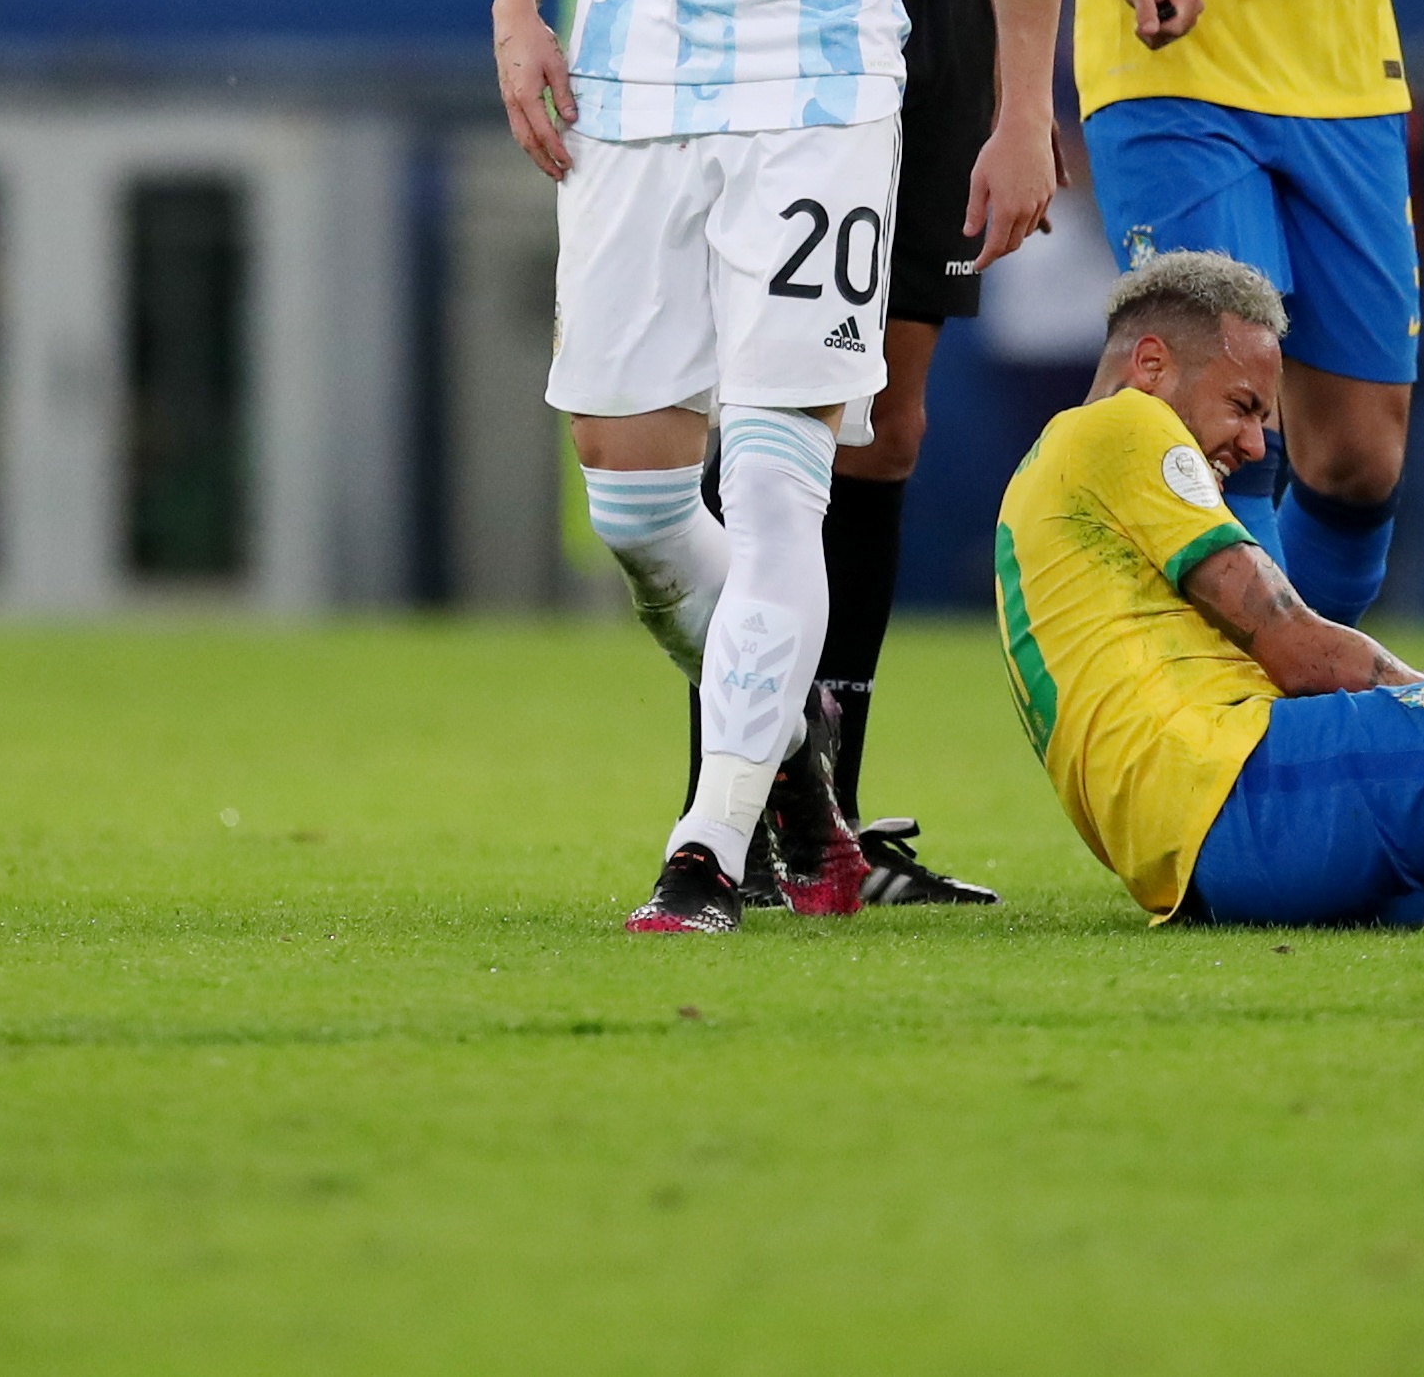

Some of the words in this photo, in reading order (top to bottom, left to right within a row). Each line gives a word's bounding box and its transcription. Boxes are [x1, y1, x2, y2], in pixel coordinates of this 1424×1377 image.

[768, 197, 882, 307] 20
[945, 260, 979, 276] mar
[823, 335, 866, 353] adidas
[723, 669, 779, 693] AFA
